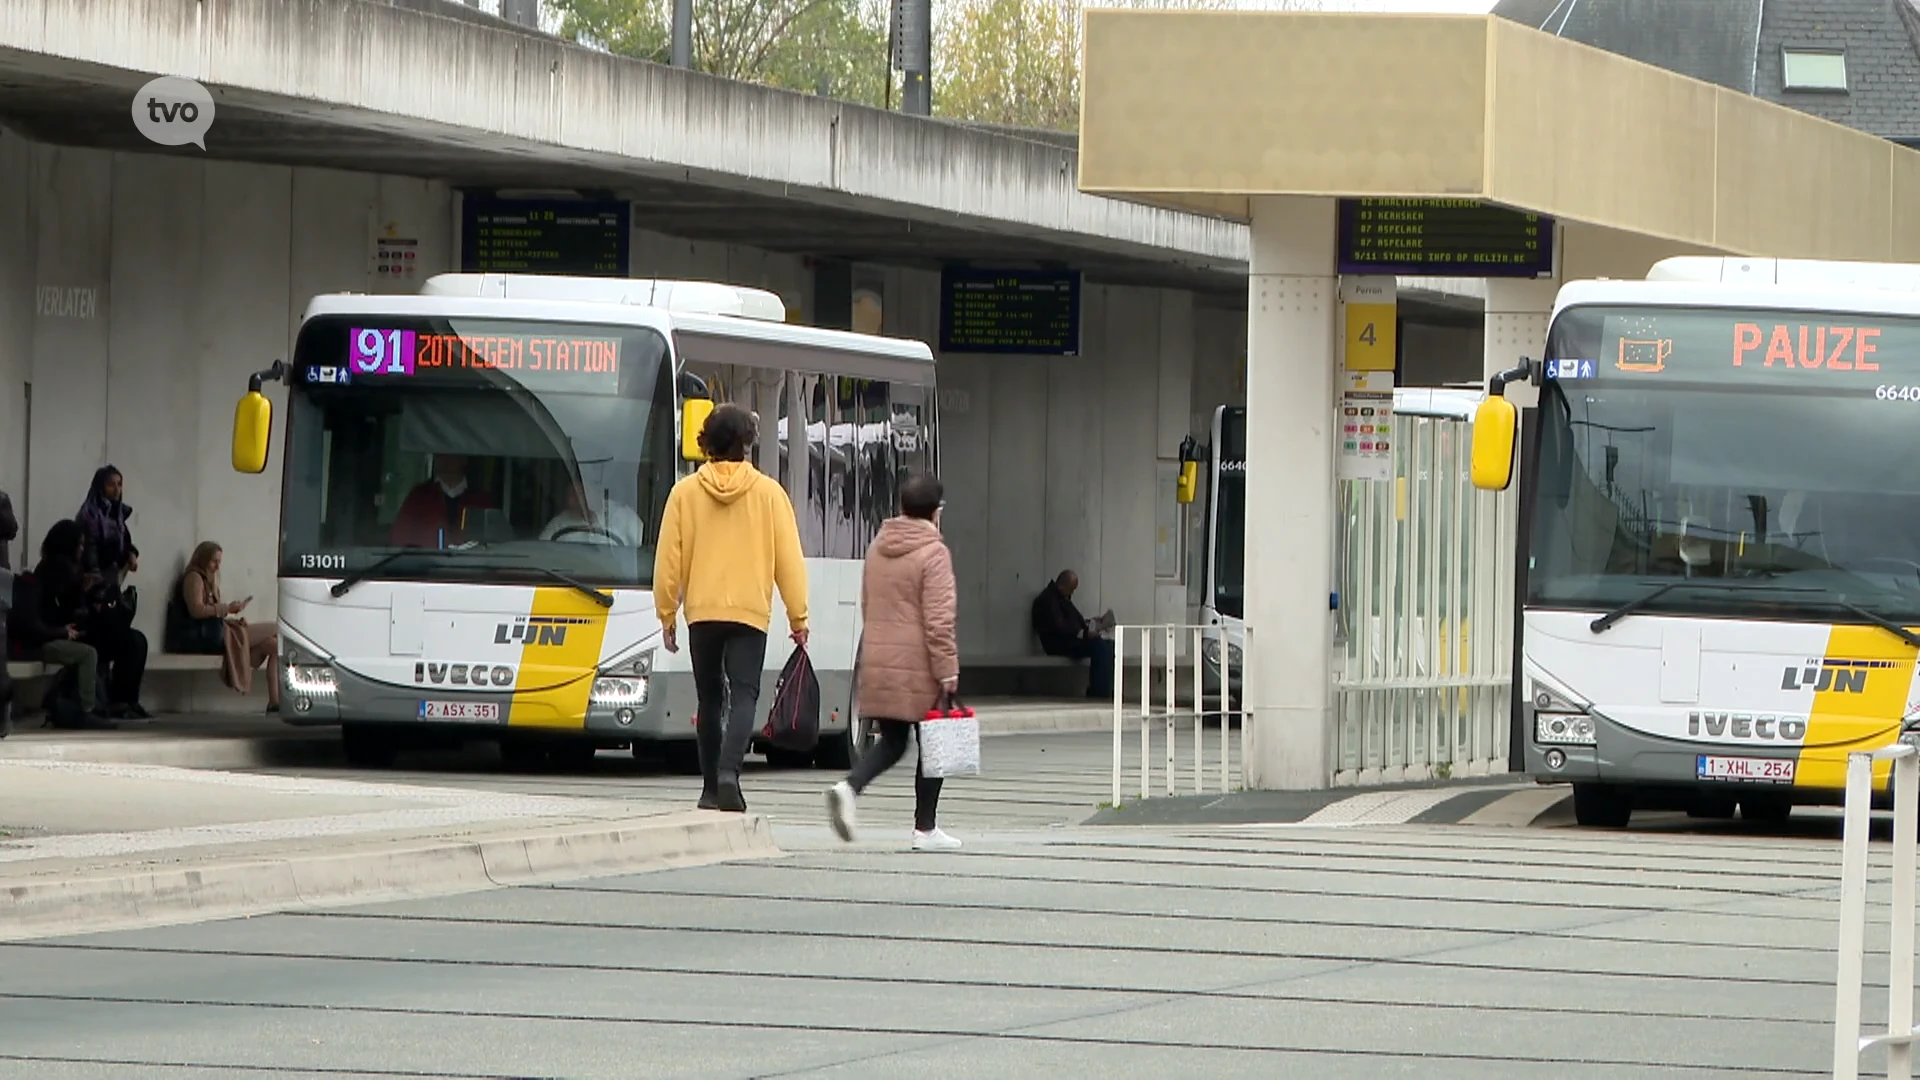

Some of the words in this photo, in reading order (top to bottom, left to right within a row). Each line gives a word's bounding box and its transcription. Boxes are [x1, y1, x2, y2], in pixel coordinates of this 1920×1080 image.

[1377, 225, 1424, 235] ASPELARE
[1377, 238, 1424, 249] ASPELARE
[1354, 251, 1378, 261] 9/11
[1383, 251, 1424, 262] STAKING
[1428, 252, 1451, 263] INFO
[1456, 253, 1469, 263] OP
[1356, 285, 1383, 295] Perron
[36, 285, 98, 320] VERLATEN
[1359, 322, 1376, 346] 4
[357, 329, 406, 373] 91
[418, 334, 524, 370] ZOTTEGEM
[529, 337, 618, 374] STATION
[1732, 323, 1882, 371] PAUZE
[1875, 384, 1920, 402] 6640
[301, 554, 345, 569] 131011
[493, 624, 567, 646] LIJN
[414, 662, 515, 686] IVECO
[1781, 667, 1867, 693] LIJN
[1688, 711, 1806, 740] IVECO
